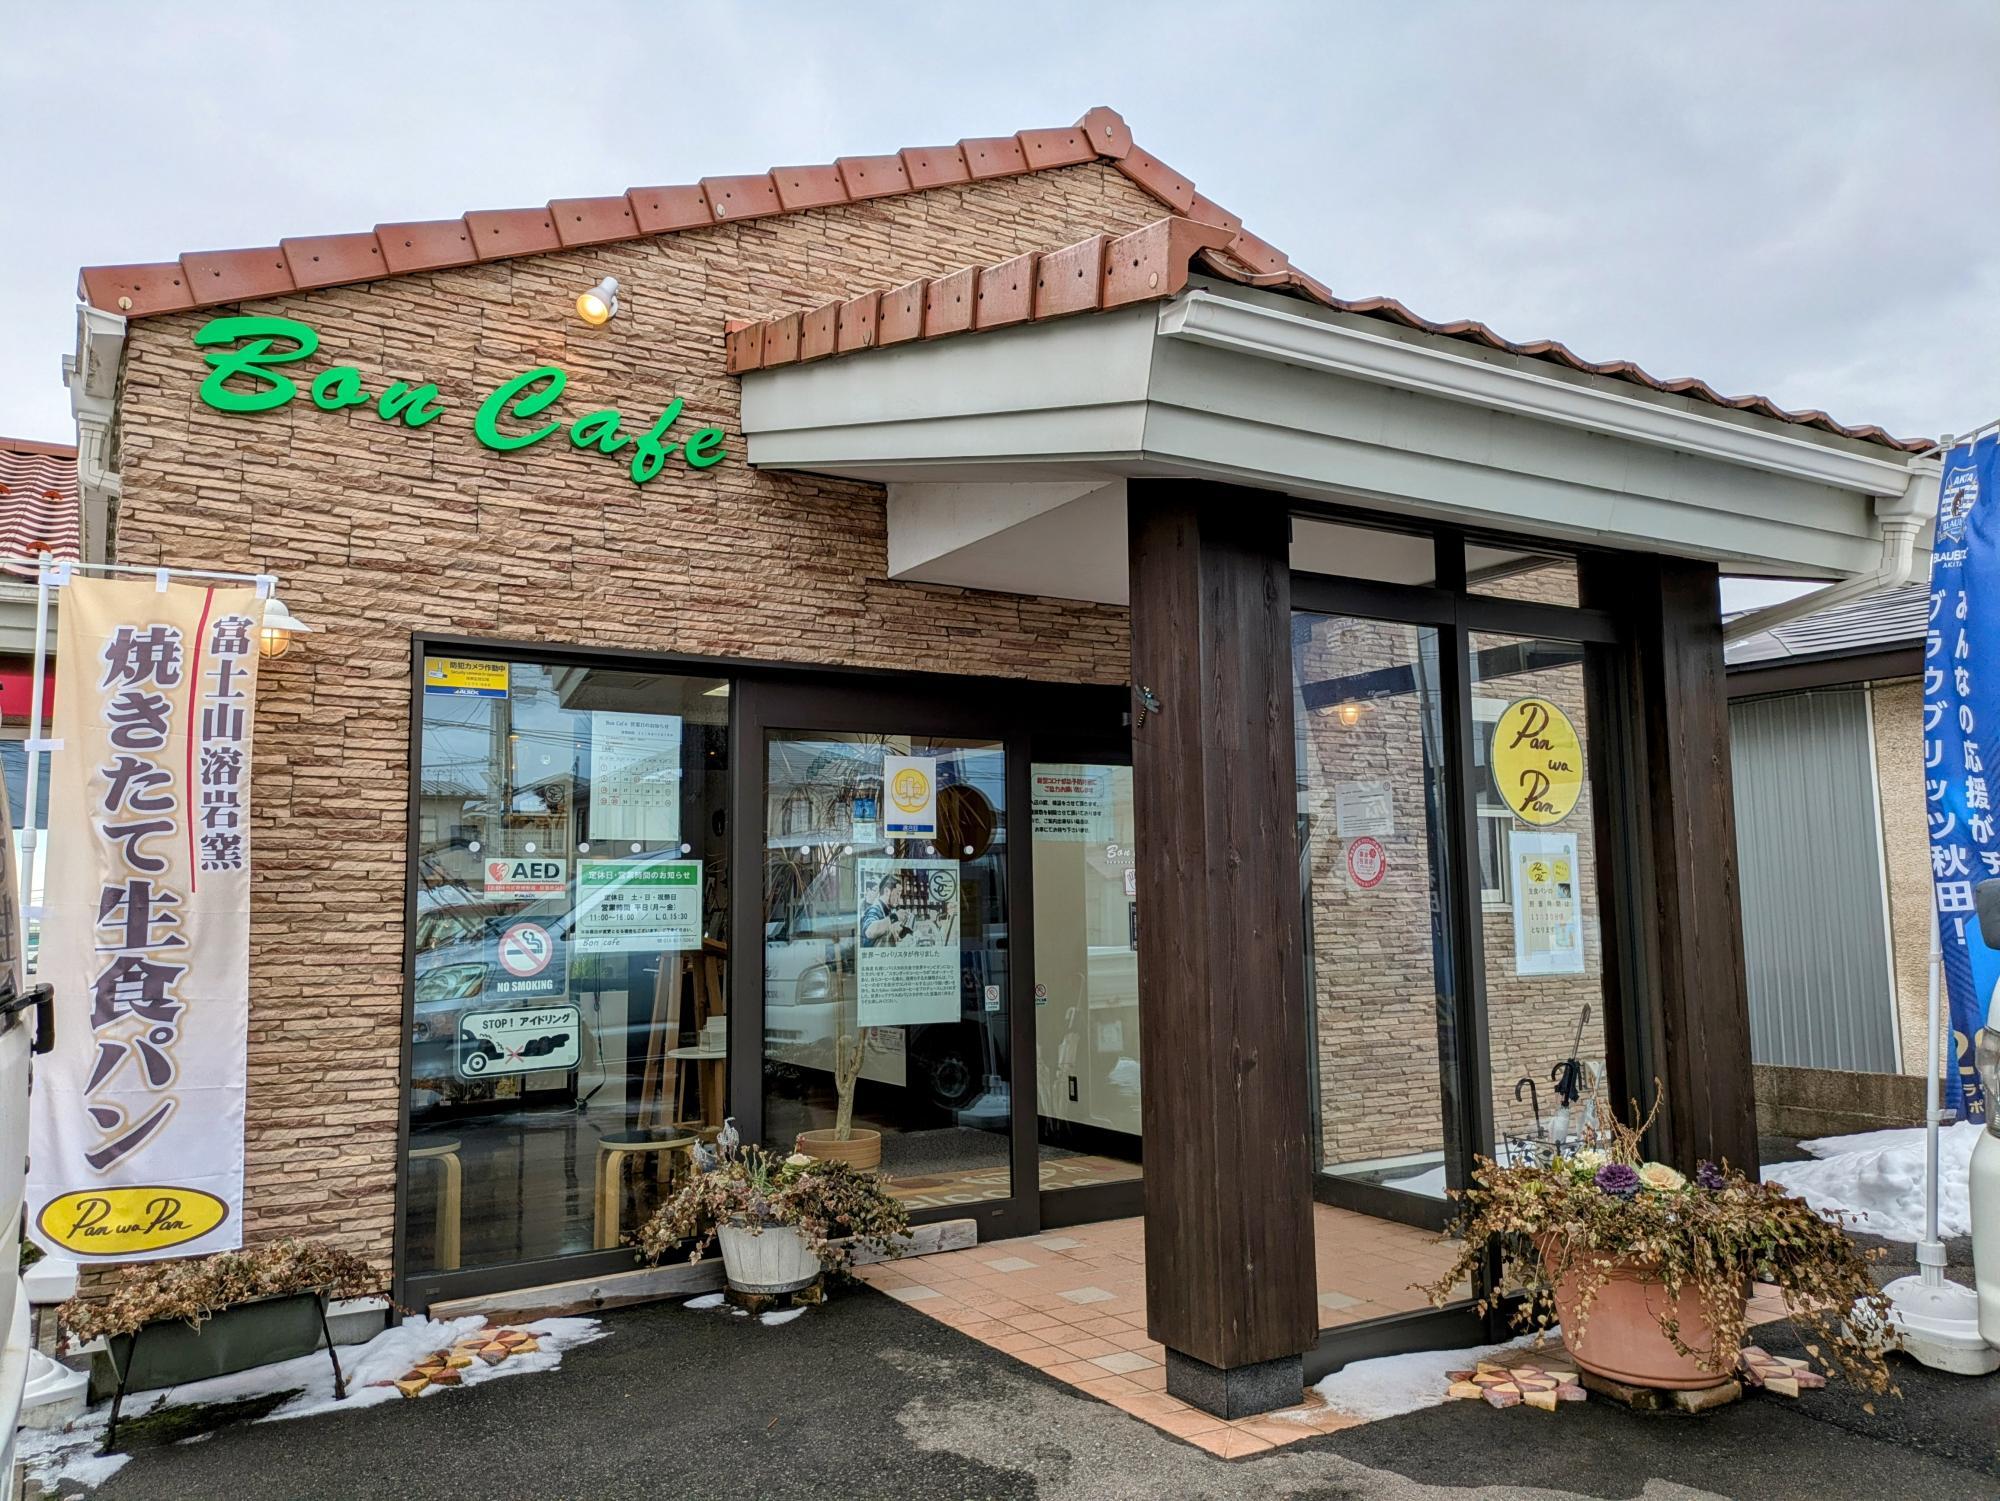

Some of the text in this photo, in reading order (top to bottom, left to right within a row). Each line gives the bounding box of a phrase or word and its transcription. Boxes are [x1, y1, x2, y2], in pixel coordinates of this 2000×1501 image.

[194, 316, 727, 484] Bon Cafe
[450, 661, 506, 672] 防犯カメラ作動中
[1510, 702, 1554, 749] Pan
[200, 616, 251, 872] 富士山溶岩窯
[1548, 758, 1574, 773] wa
[1519, 769, 1561, 815] Pan
[1106, 845, 1131, 858] Bon
[512, 863, 560, 878] AED
[589, 871, 691, 880] 定休日・営業時間のお知らせ
[85, 627, 184, 1171] 焼きたて生食パン
[497, 980, 553, 993] NO SMOKING
[520, 1013, 571, 1026] アイドリング
[66, 1198, 194, 1239] Pan wa Pan
